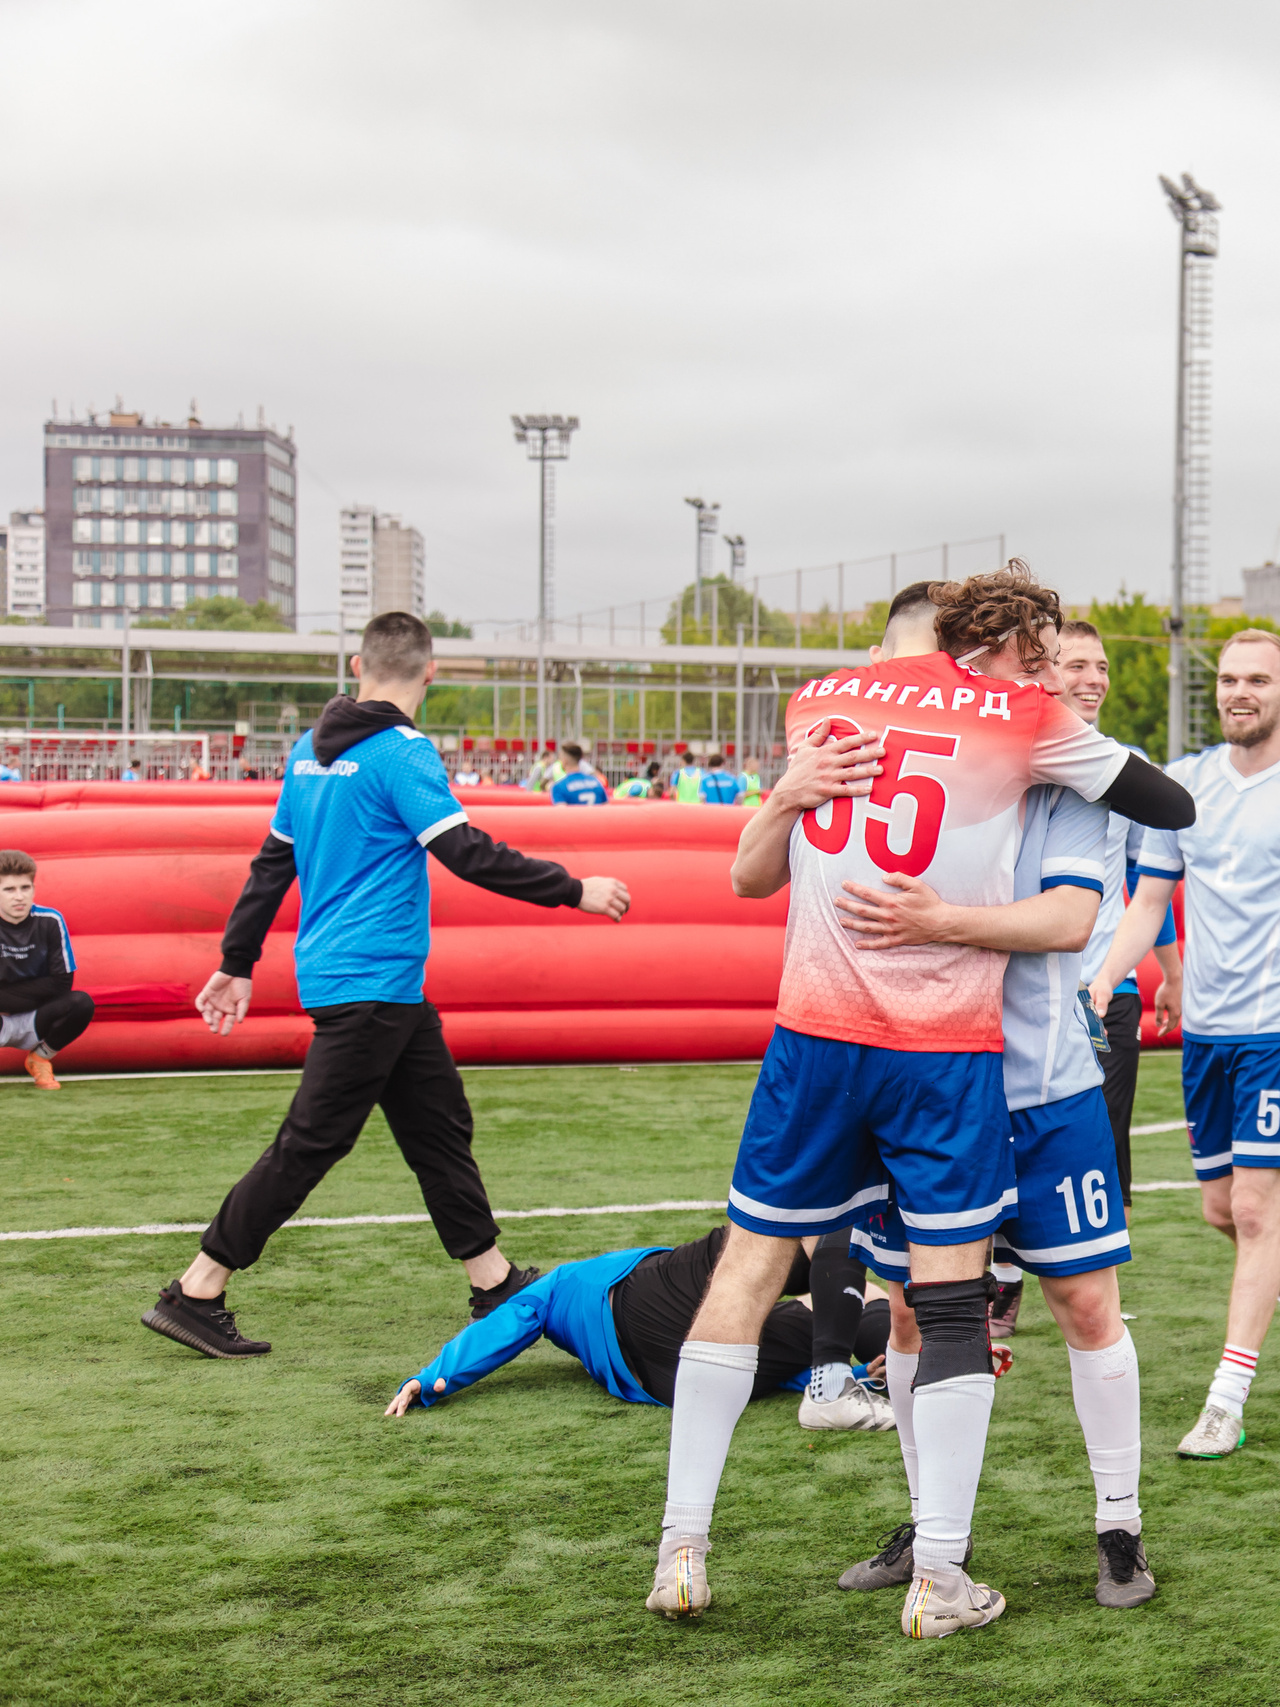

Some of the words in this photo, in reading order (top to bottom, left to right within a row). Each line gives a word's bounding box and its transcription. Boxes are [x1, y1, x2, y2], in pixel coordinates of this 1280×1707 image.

[797, 677, 1011, 721] АВАНГАРД
[1257, 1089, 1280, 1137] 5
[1055, 1169, 1109, 1234] 16
